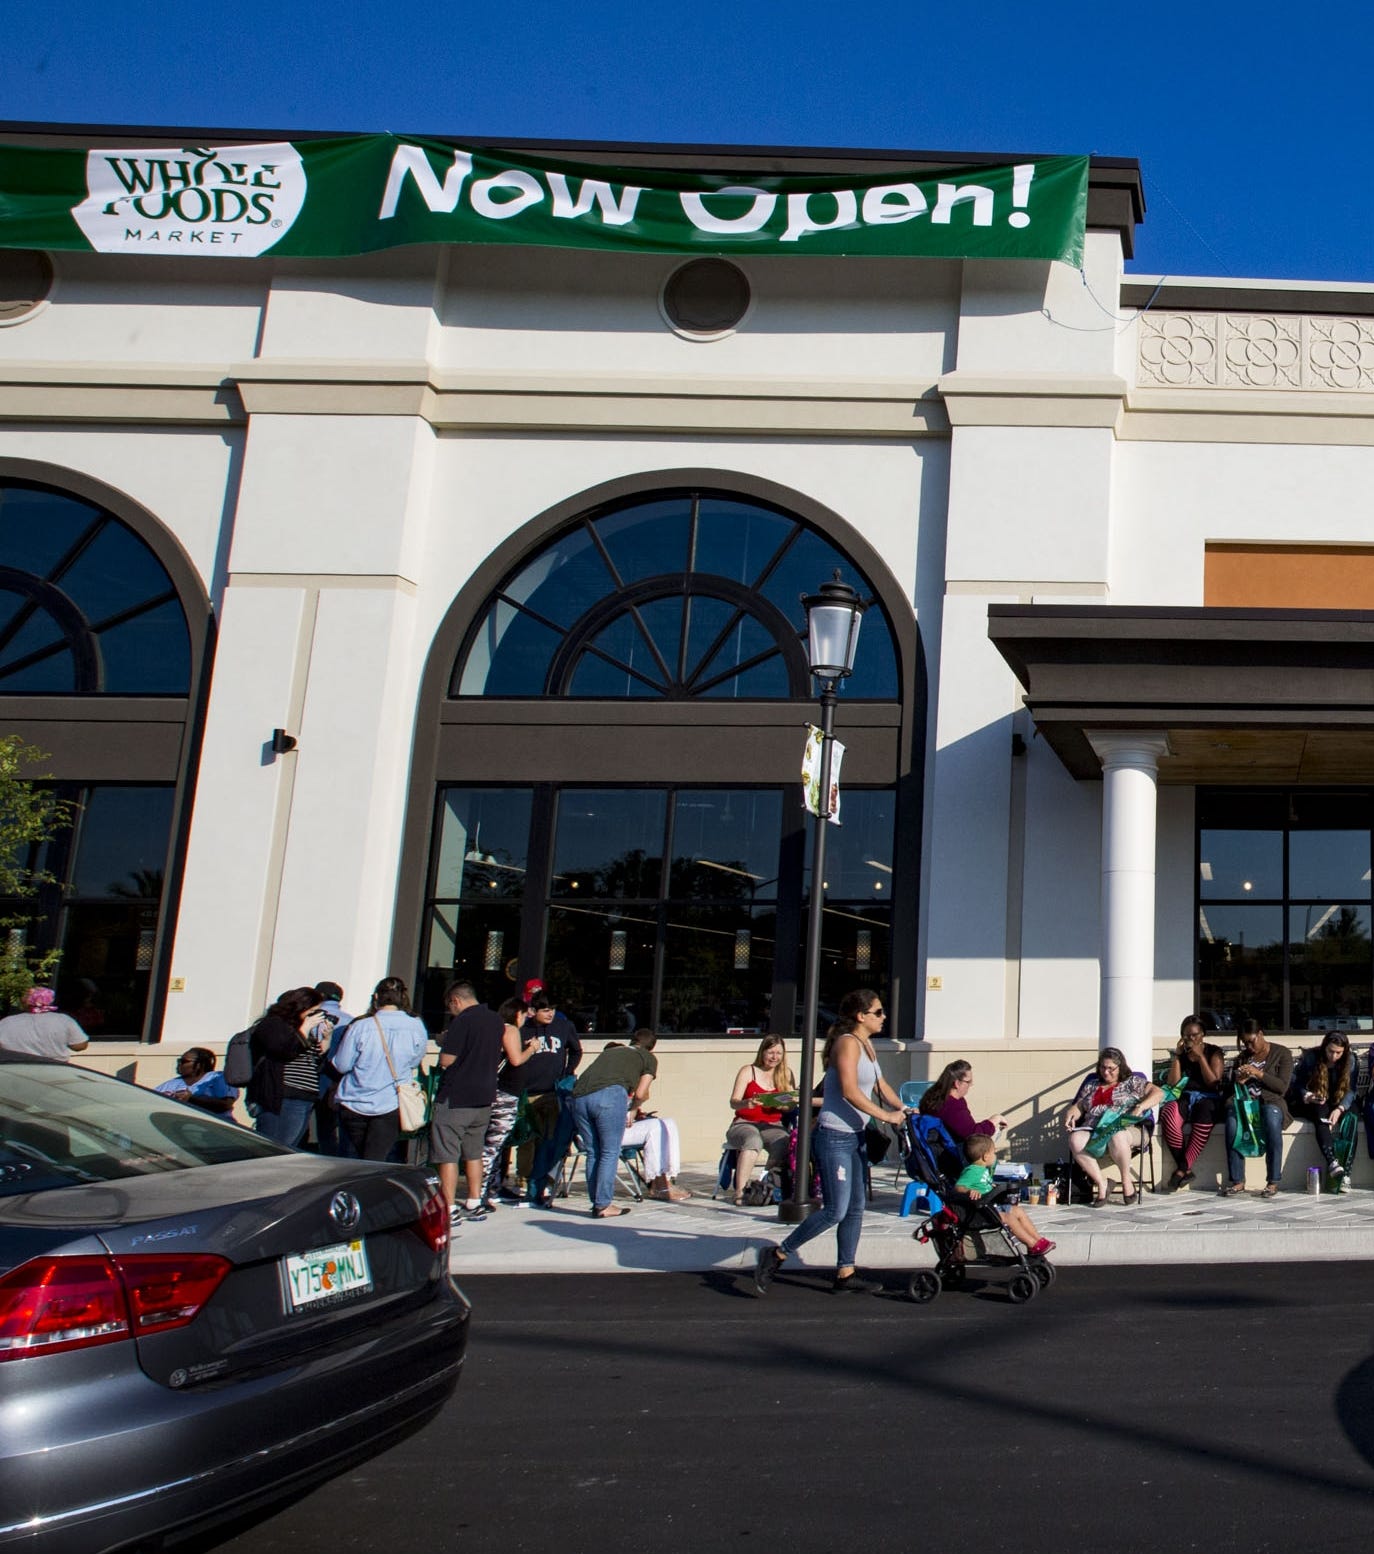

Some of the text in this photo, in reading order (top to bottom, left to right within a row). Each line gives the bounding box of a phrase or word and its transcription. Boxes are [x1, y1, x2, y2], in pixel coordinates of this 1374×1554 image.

[104, 150, 281, 193] WHOLE
[378, 144, 1036, 242] Now Open!
[124, 229, 244, 244] MARKET
[533, 1035, 562, 1054] AP
[129, 1224, 199, 1247] PASSAT
